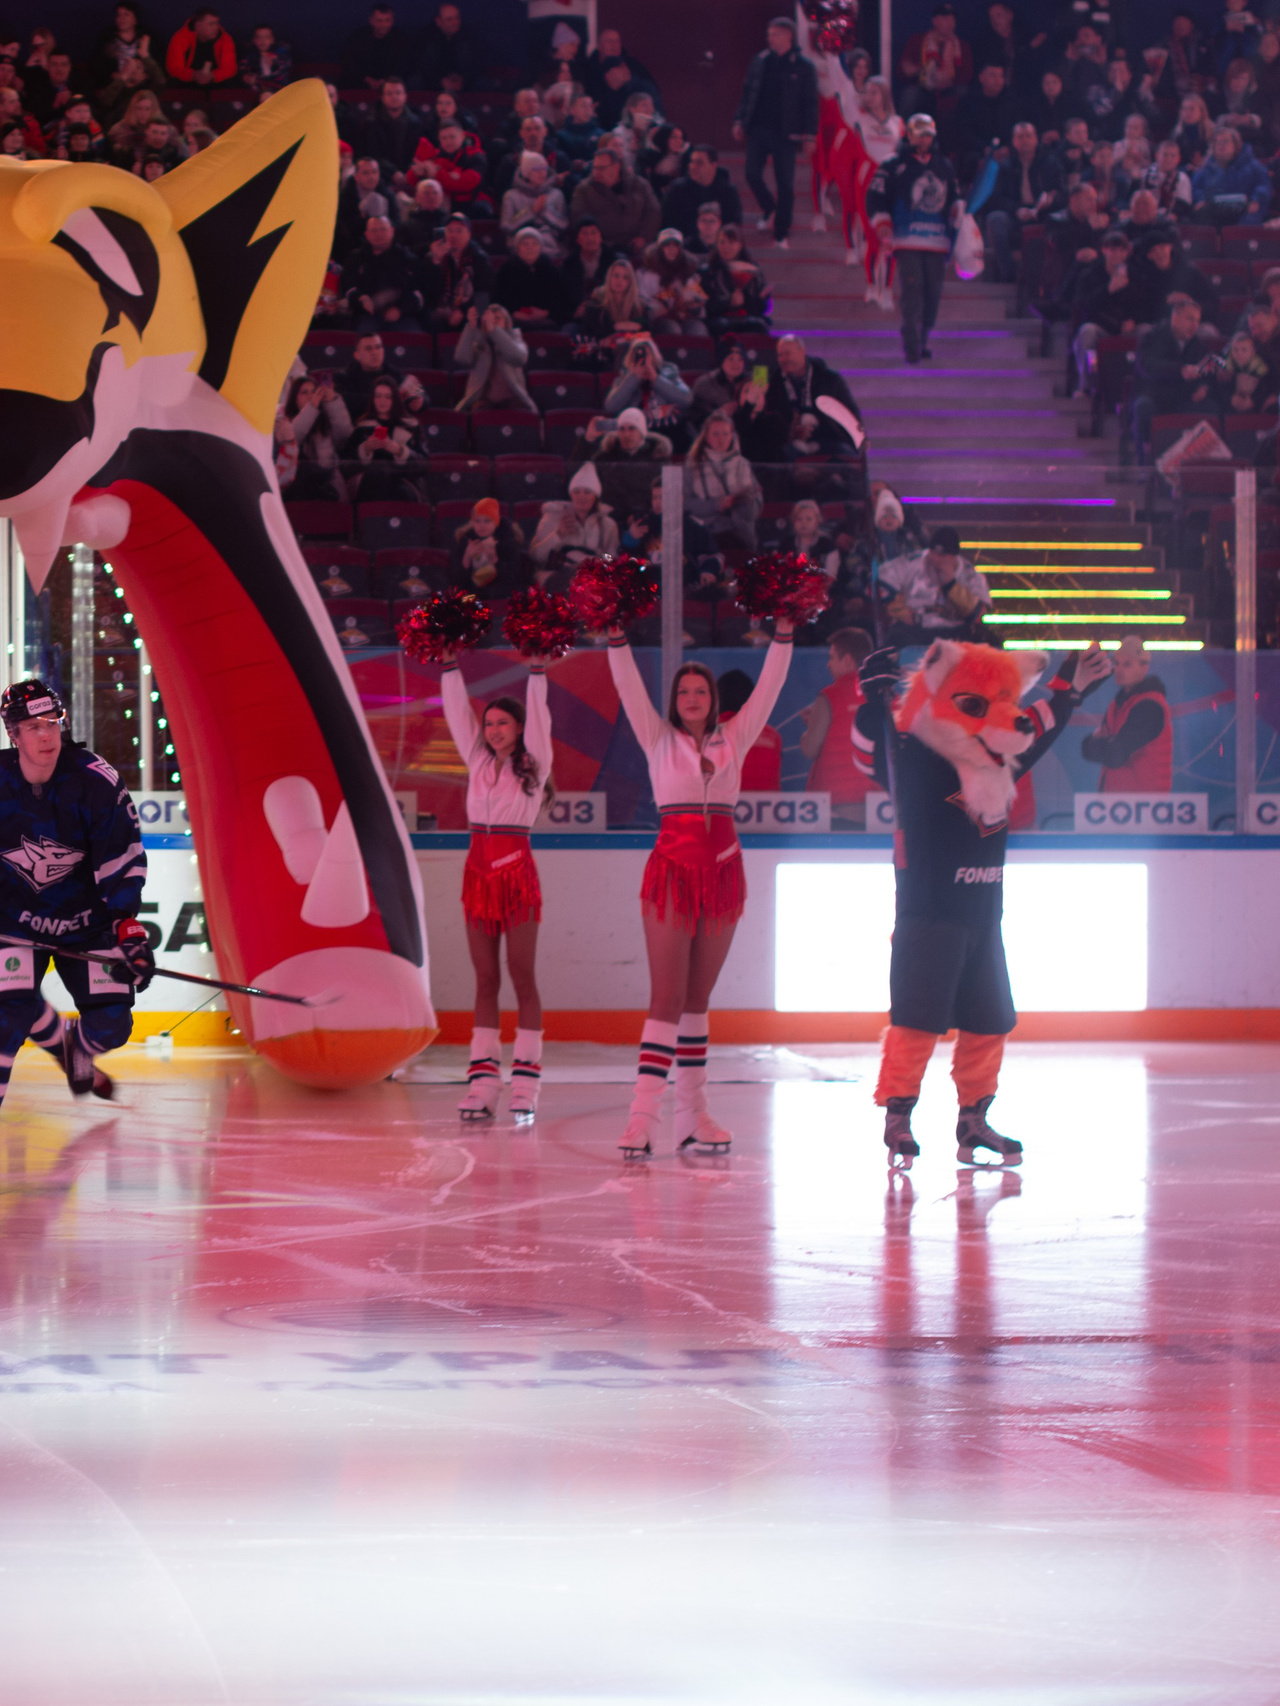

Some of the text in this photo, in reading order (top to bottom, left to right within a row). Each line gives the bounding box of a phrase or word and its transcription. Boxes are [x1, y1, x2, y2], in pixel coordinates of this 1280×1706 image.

[733, 800, 819, 824] огаз
[1084, 801, 1197, 825] согаз
[954, 866, 1003, 884] FONBE
[19, 908, 93, 936] FONBET
[292, 1347, 780, 1373] УРАЛ
